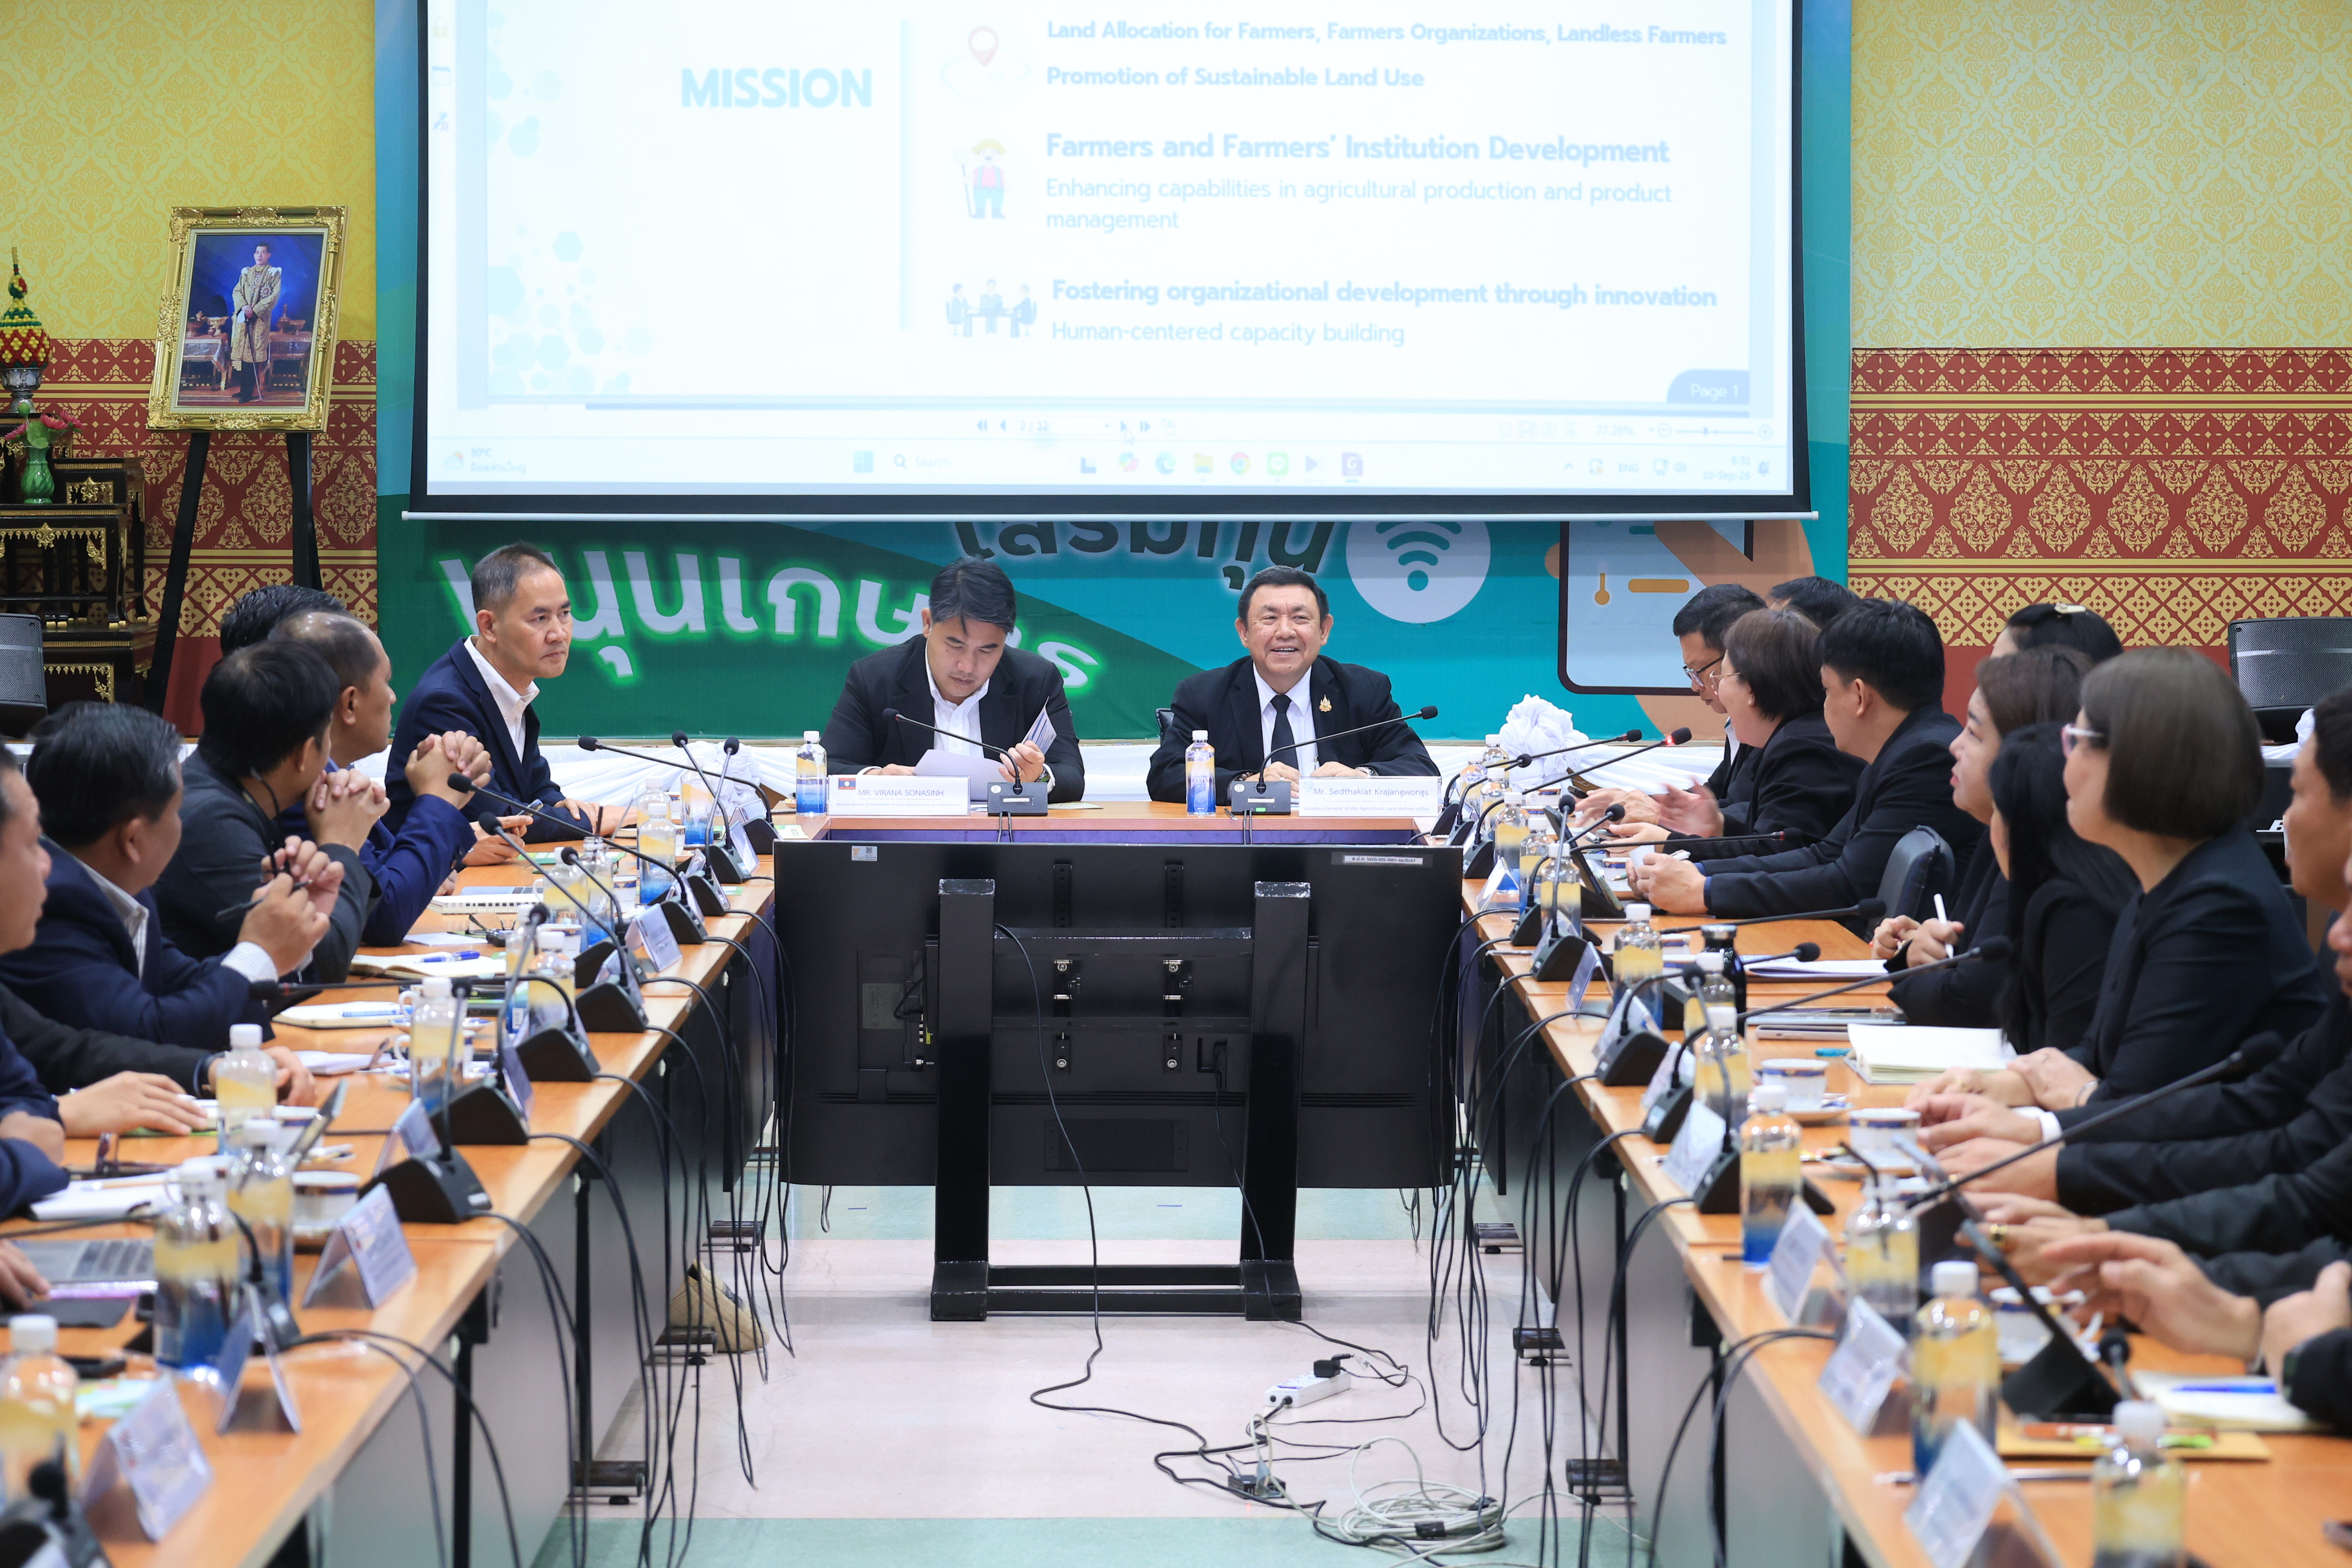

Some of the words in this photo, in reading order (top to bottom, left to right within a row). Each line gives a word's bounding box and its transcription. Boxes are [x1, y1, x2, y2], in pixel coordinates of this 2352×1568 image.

[1047, 20, 1096, 38] Land
[1102, 20, 1199, 39] Allocation
[1204, 21, 1233, 39] for
[1238, 22, 1321, 43] Farmers,
[1327, 22, 1405, 40] Farmers
[1410, 22, 1551, 45] Organizations,
[1557, 22, 1644, 43] Landless
[1647, 25, 1728, 45] Farmers
[681, 67, 873, 109] MISSION
[1047, 66, 1159, 85] Promotion
[1165, 66, 1190, 85] of
[1195, 66, 1319, 86] Sustainable
[1325, 67, 1378, 87] Land
[1384, 68, 1425, 87] Use
[1047, 132, 1154, 158] Farmers
[1162, 132, 1214, 158] and
[1346, 134, 1480, 159] Institution
[1489, 135, 1671, 169] Development
[1047, 178, 1151, 202] Enhancing
[1158, 178, 1272, 202] capabilities
[1280, 180, 1296, 197] in
[1304, 179, 1416, 204] agricultural
[1424, 180, 1536, 204] production
[1544, 181, 1583, 201] and
[1590, 183, 1672, 206] product
[1046, 211, 1179, 234] management
[1053, 279, 1160, 306] Fostering
[1166, 279, 1329, 306] organizational
[1336, 280, 1489, 308] development
[1494, 281, 1587, 310] through
[1595, 283, 1717, 306] innovation
[1052, 321, 1223, 341] Human-centered
[1230, 323, 1316, 347] capacity
[1324, 322, 1404, 348] building
[1690, 383, 1727, 402] Page
[1733, 384, 1740, 397] 1
[915, 456, 951, 468] Search
[1618, 463, 1639, 473] ENG
[1374, 788, 1429, 797] Krajangwongs
